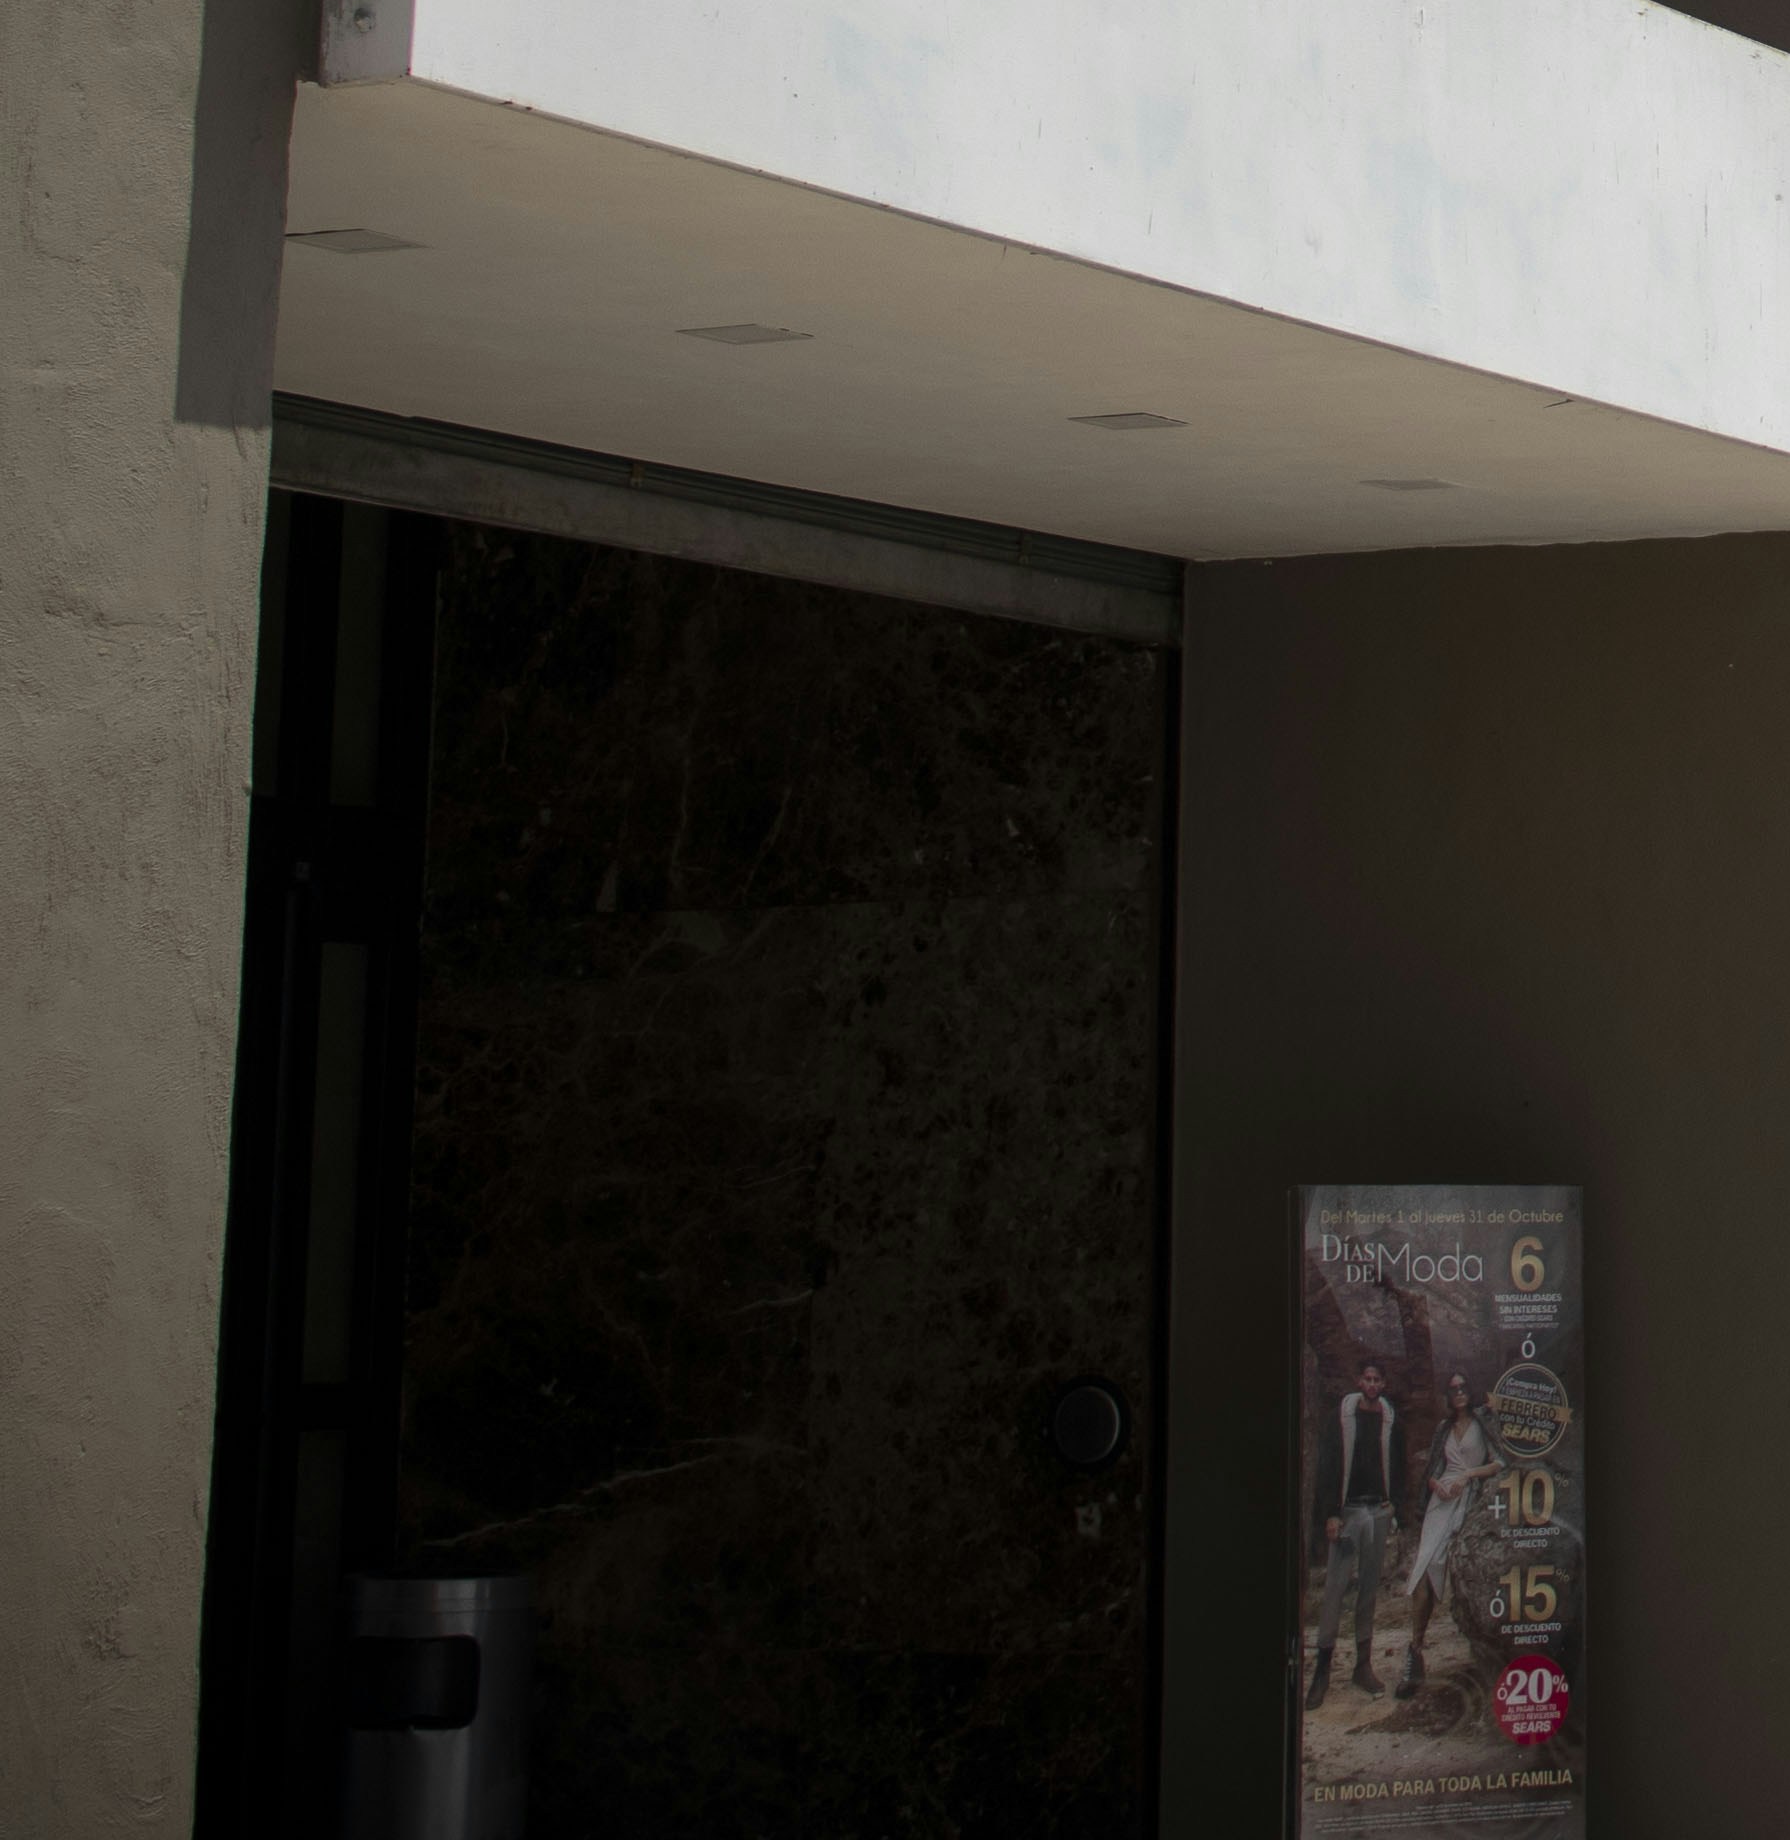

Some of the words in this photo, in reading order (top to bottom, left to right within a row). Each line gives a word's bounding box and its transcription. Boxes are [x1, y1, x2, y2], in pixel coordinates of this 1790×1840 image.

[1320, 1210, 1343, 1224] Del
[1346, 1210, 1393, 1224] Martes
[1397, 1210, 1404, 1224] 1
[1408, 1209, 1422, 1223] al
[1468, 1209, 1484, 1223] 31
[1487, 1209, 1506, 1223] de
[1509, 1208, 1564, 1223] Octubre
[1346, 1264, 1376, 1283] DE
[1377, 1242, 1483, 1283] Moda
[1510, 1236, 1545, 1292] 6
[1501, 1397, 1556, 1419] FEBRERO
[1502, 1423, 1551, 1443] SEARS
[1501, 1529, 1512, 1537] DE
[1513, 1527, 1560, 1537] DESCUENTO
[1514, 1539, 1548, 1548] DIRECTO
[1501, 1624, 1513, 1633] DE
[1514, 1622, 1561, 1633] DESCUENTO
[1514, 1635, 1549, 1644] DIRECTO
[1512, 1720, 1552, 1734] SEARS
[1314, 1787, 1336, 1802] EN
[1340, 1782, 1388, 1800] MODA
[1393, 1779, 1435, 1796] PARA
[1439, 1776, 1482, 1793] TODA
[1486, 1773, 1507, 1789] LA
[1511, 1769, 1573, 1788] FAMILIA
